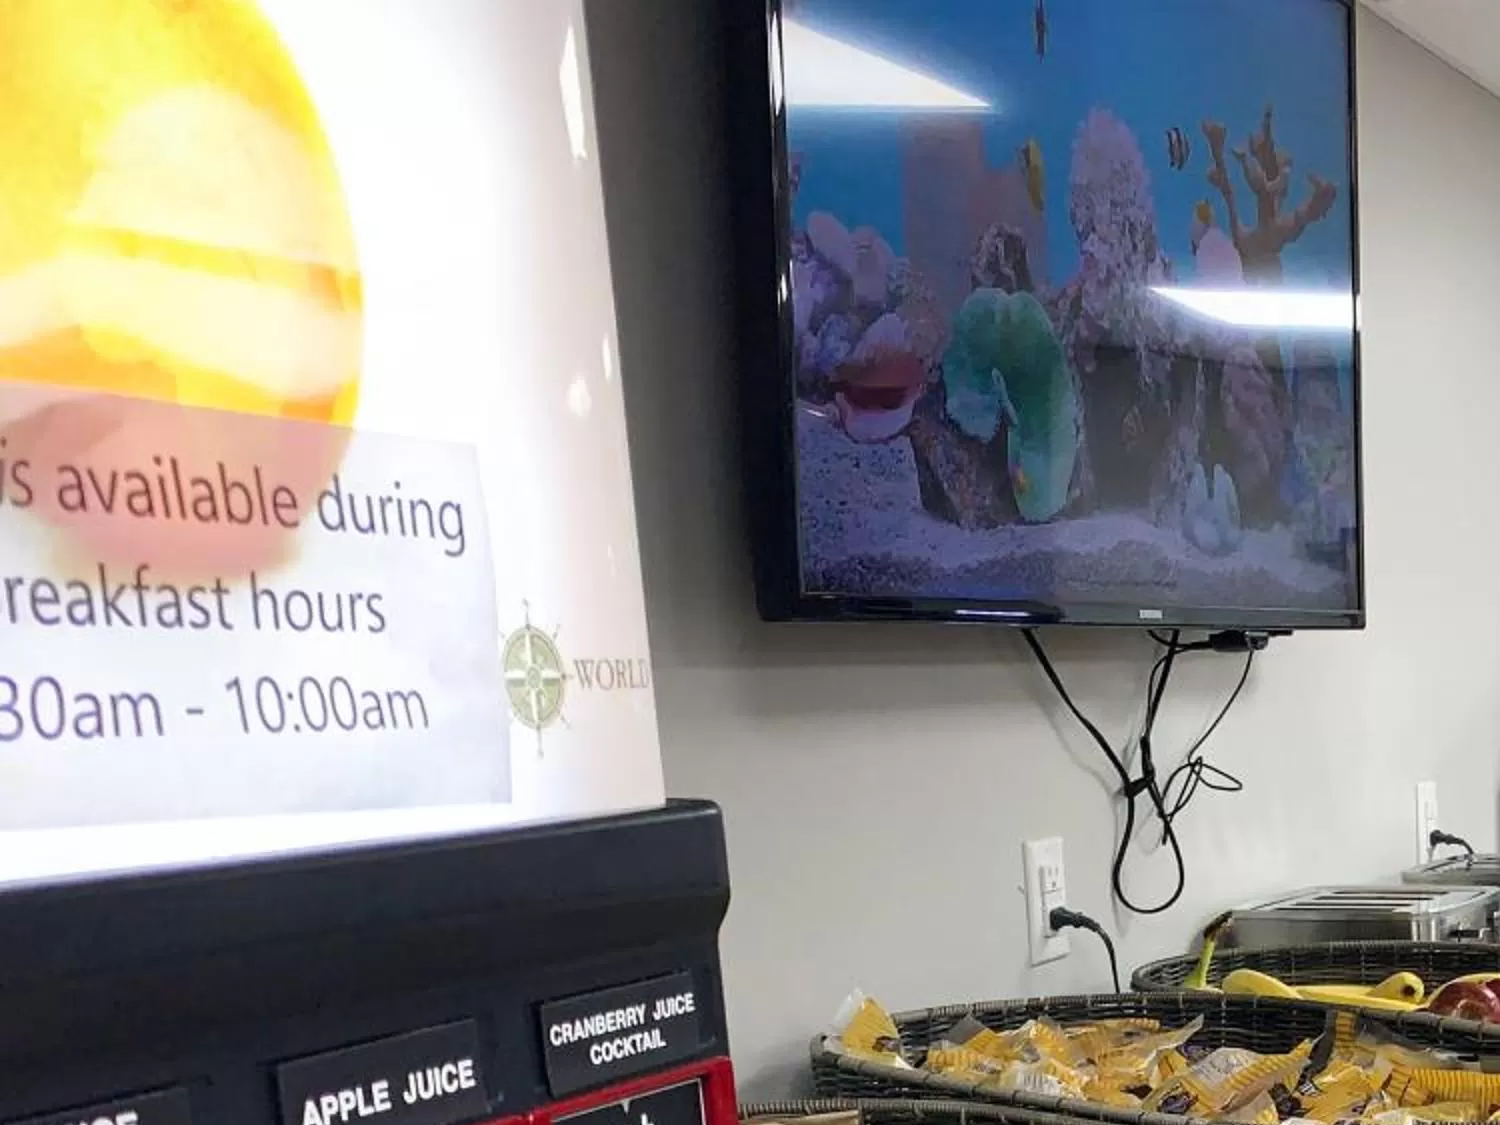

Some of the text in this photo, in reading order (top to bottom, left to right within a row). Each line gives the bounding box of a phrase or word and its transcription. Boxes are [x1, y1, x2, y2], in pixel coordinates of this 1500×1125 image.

[57, 456, 299, 529] available
[318, 482, 465, 557] during
[0, 562, 387, 634] reakfast hours
[573, 657, 650, 691] WORLD
[225, 676, 430, 734] 10:00am
[549, 993, 696, 1046] CRANBERRY JUICE
[589, 1029, 666, 1065] COCKTAIL
[402, 1060, 475, 1104] JUICE
